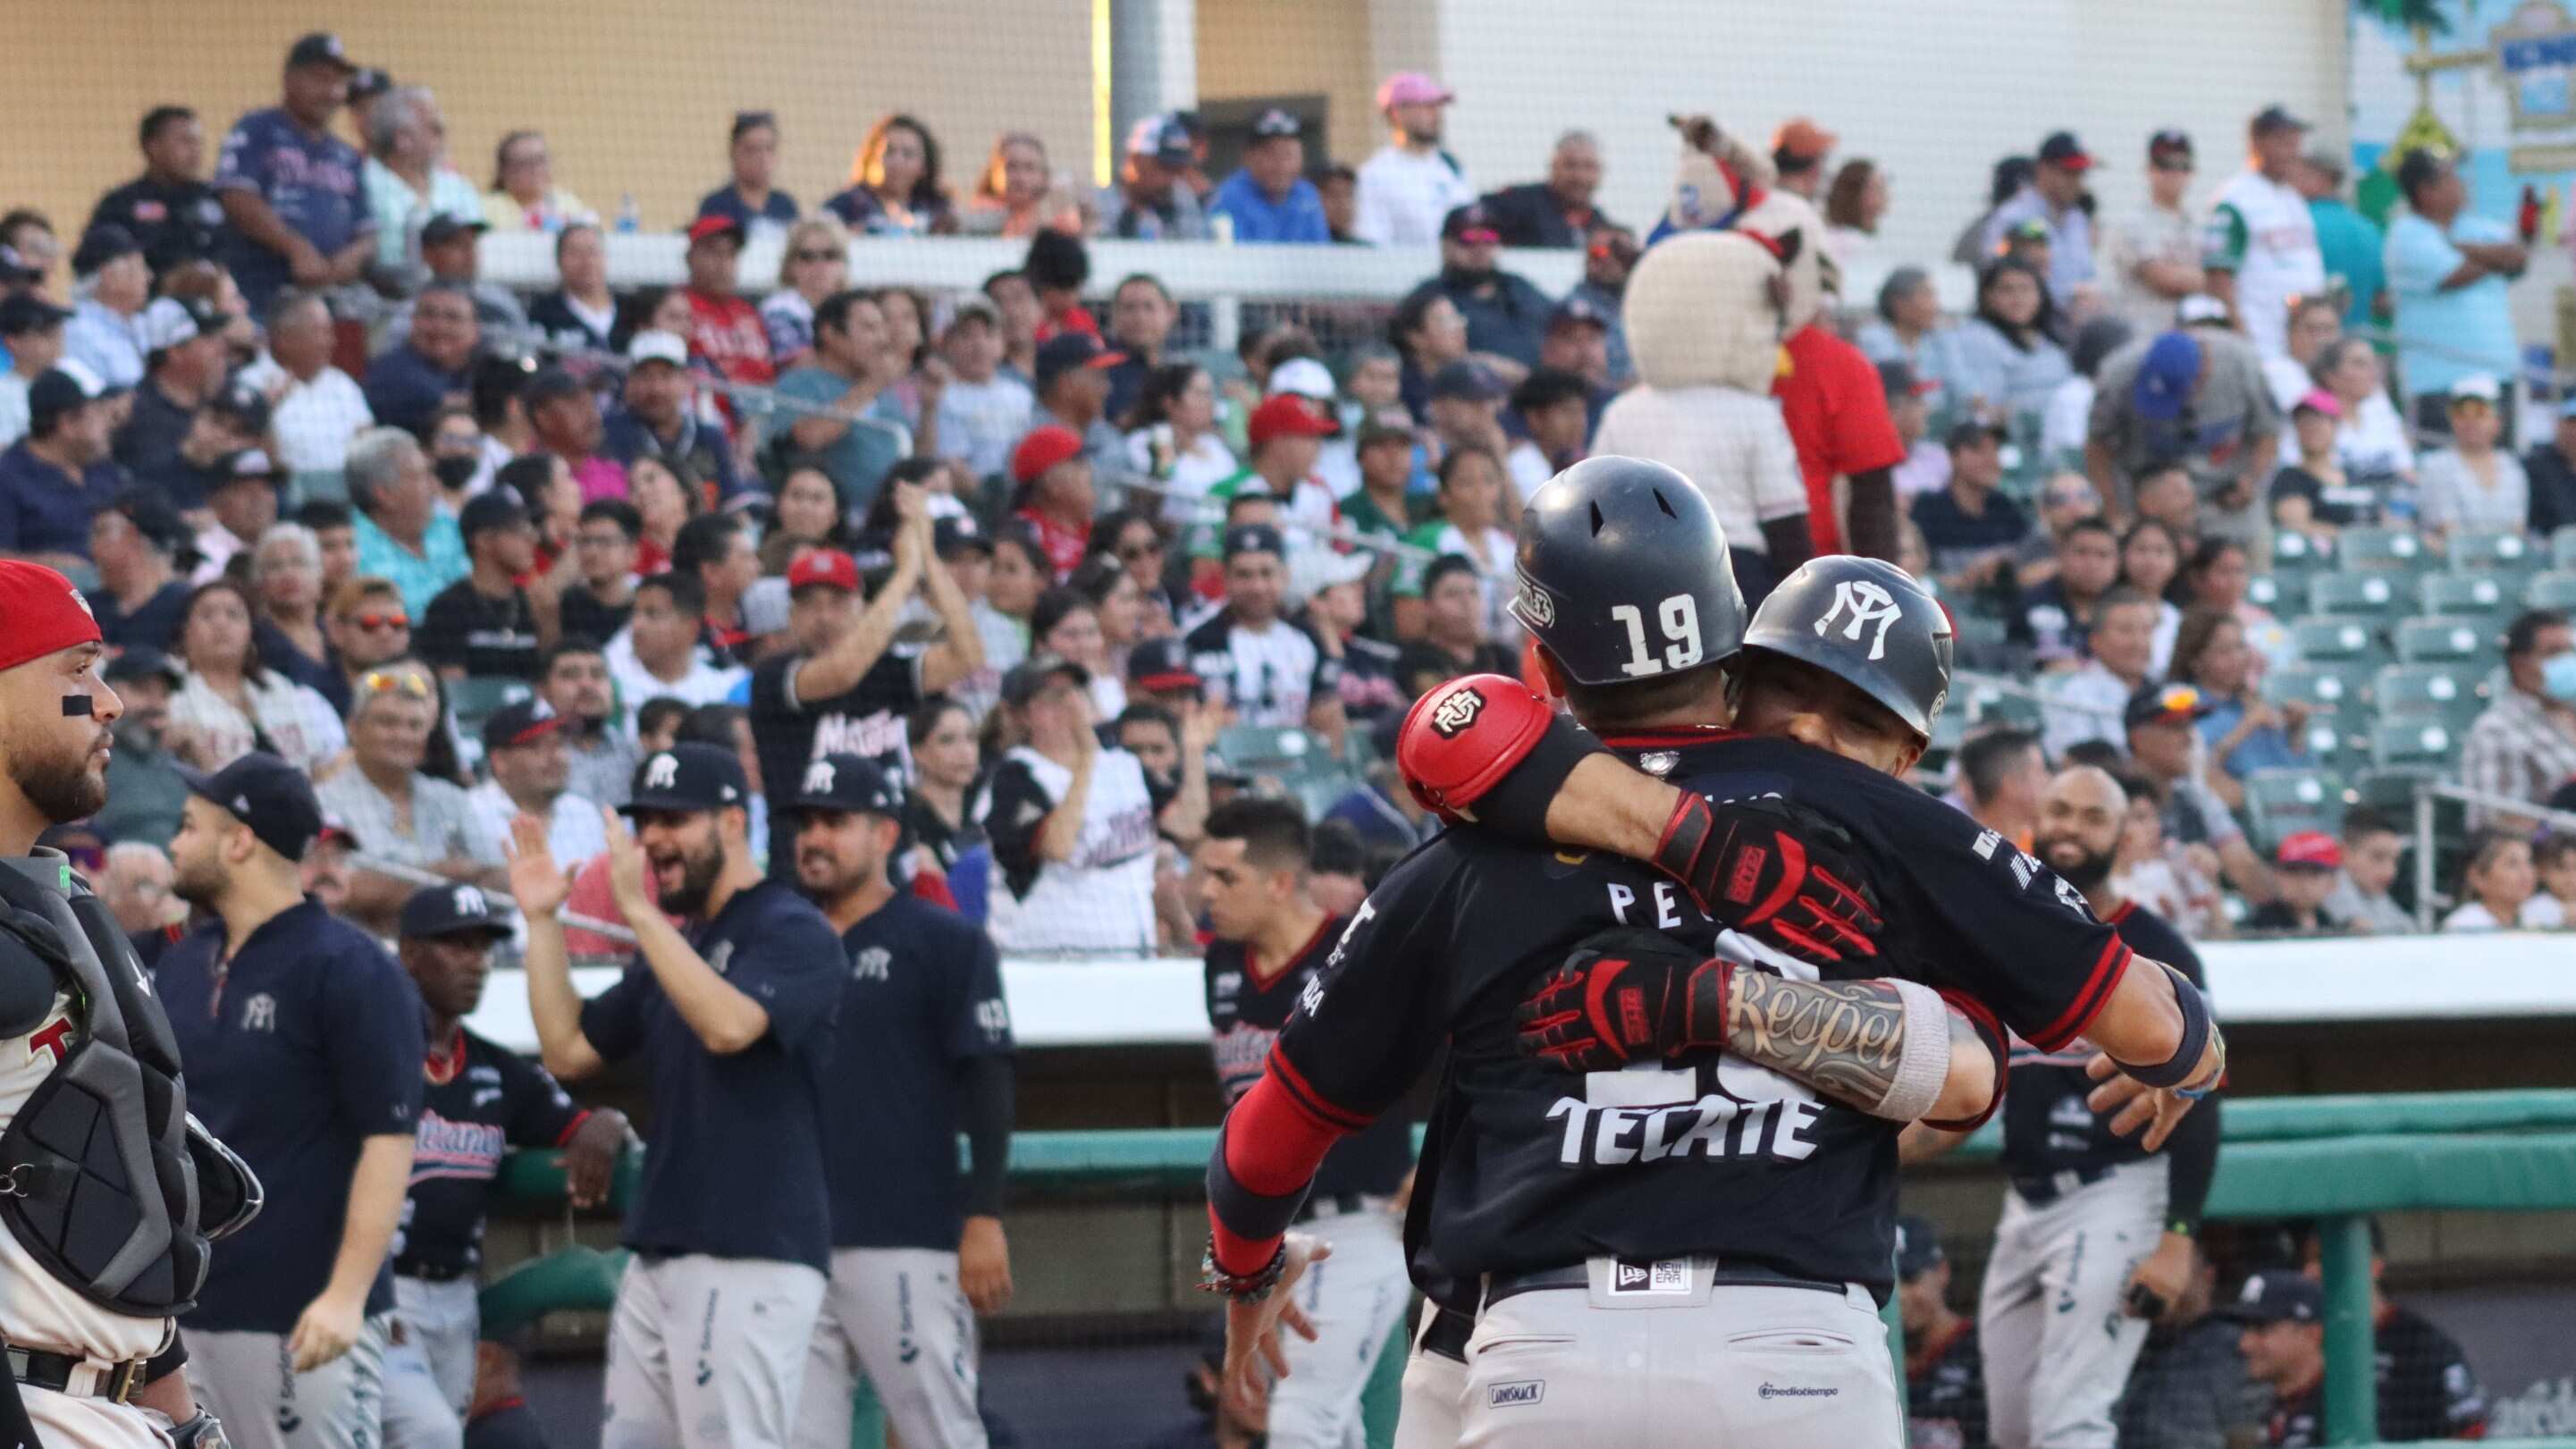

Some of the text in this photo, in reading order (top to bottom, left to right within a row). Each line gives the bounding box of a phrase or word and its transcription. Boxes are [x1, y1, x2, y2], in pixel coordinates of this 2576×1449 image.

[1612, 594, 1703, 677] 19
[1545, 1093, 1826, 1165] TECATE
[1655, 1273, 1681, 1284] ERA
[1656, 1261, 1681, 1273] NEW
